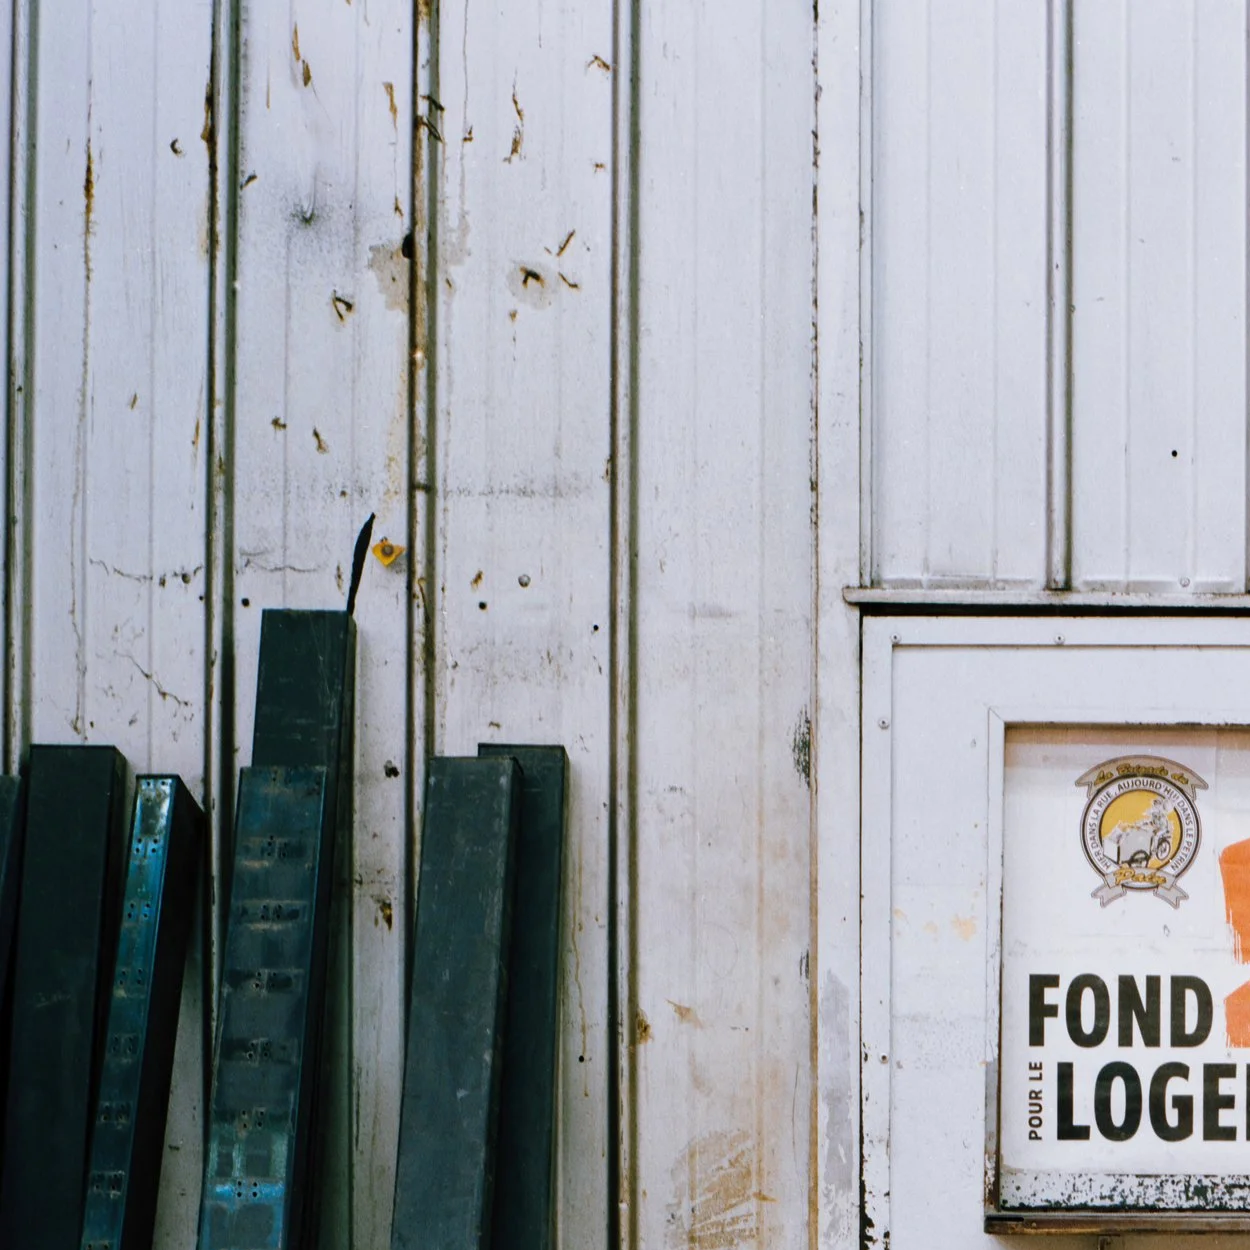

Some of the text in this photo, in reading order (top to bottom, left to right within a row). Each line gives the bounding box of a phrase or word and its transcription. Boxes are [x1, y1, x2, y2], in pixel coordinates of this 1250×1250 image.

[1091, 809, 1101, 820] LA
[1177, 801, 1193, 830] DANS
[1088, 821, 1099, 849] DANS
[1185, 828, 1194, 839] LE
[1029, 1061, 1043, 1141] POUR LE
